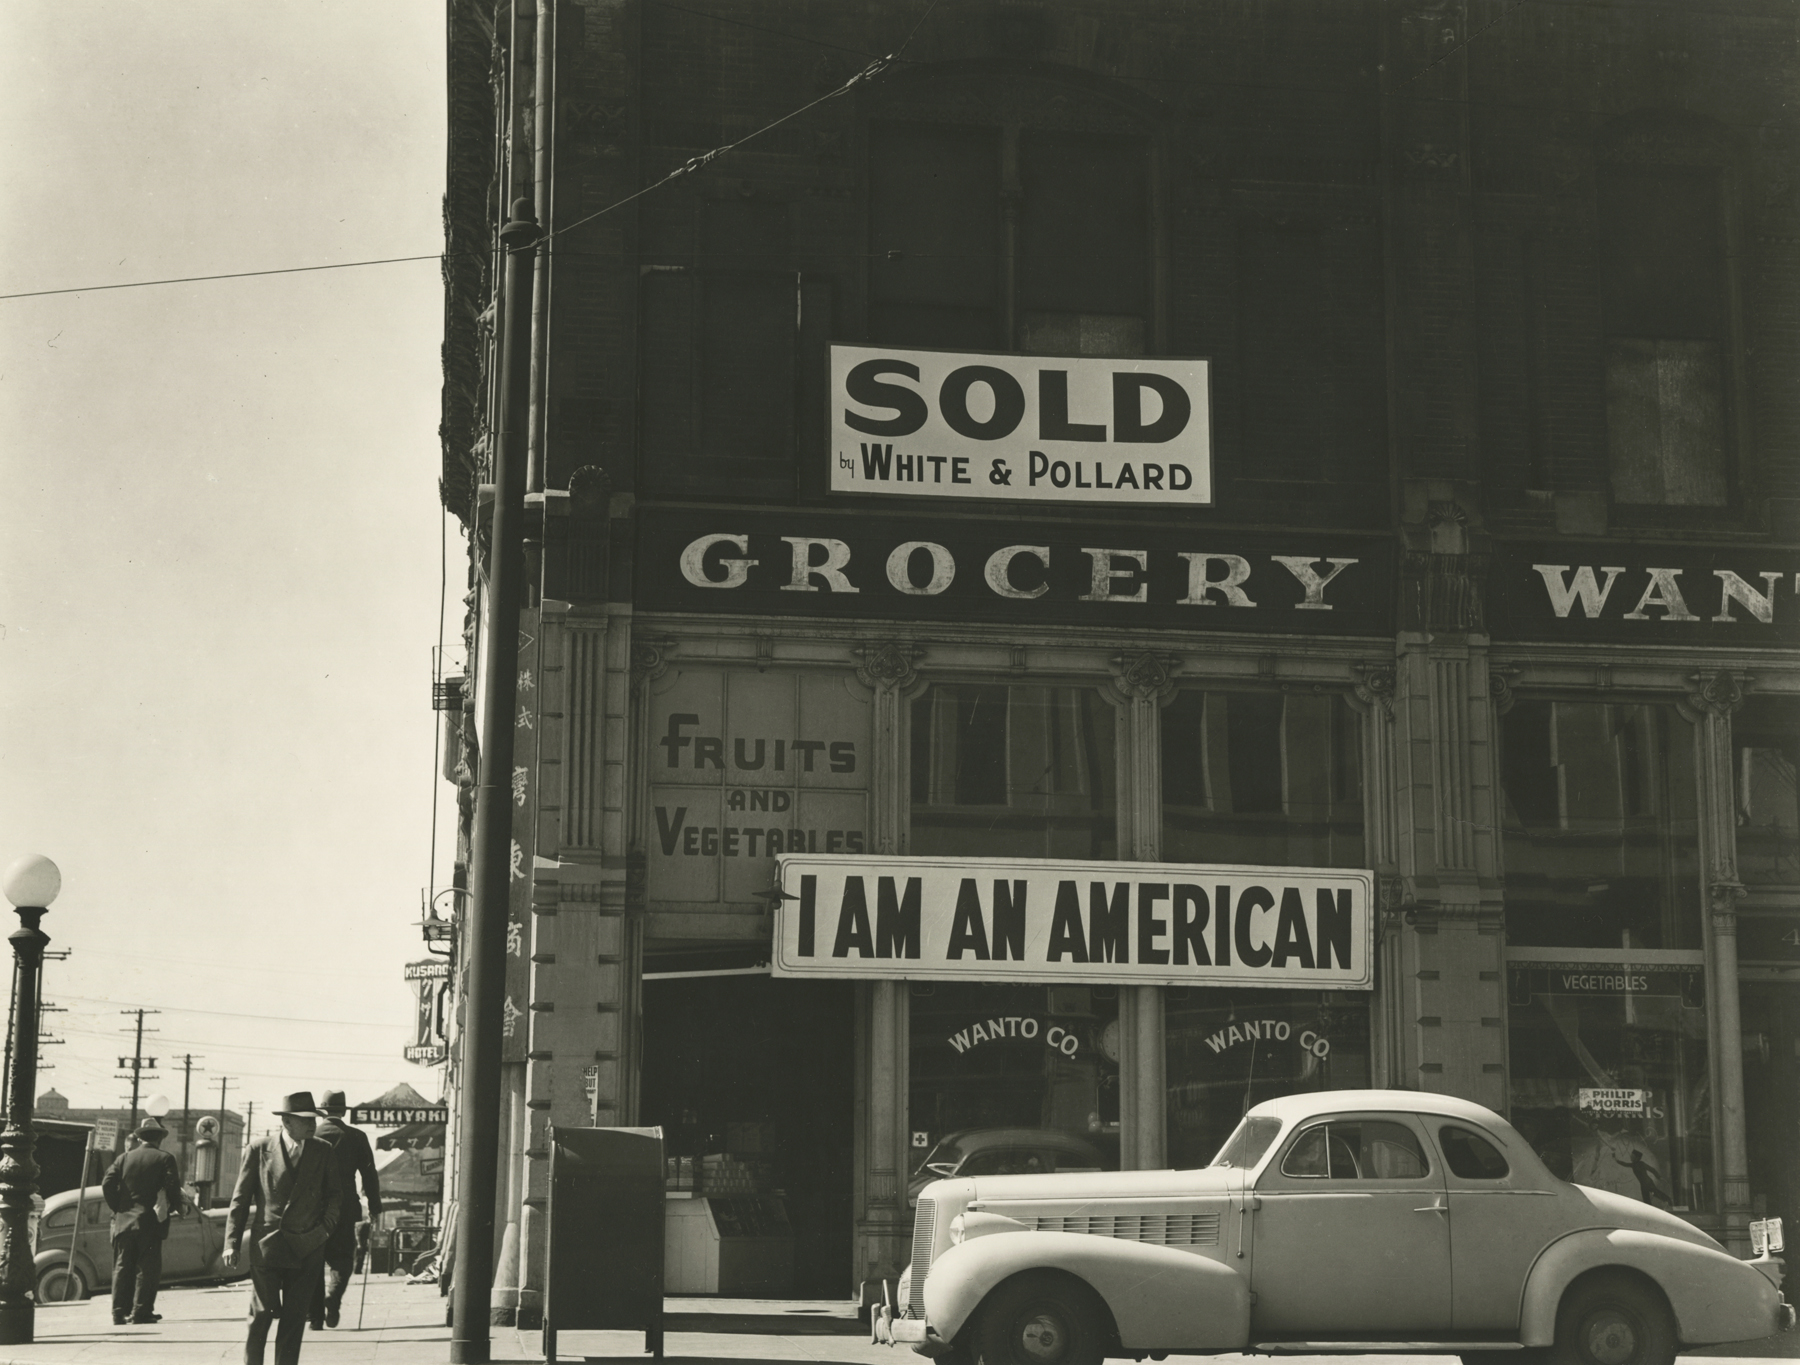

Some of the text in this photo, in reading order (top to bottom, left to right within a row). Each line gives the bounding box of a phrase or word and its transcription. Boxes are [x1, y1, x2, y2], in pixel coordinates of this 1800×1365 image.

[845, 359, 1191, 443] SOLD
[840, 443, 1193, 490] by WHITE & POLLARD
[679, 533, 1359, 610] GROCERY
[1532, 564, 1800, 623] WAN
[659, 713, 856, 773] FRUITS
[727, 789, 791, 812] AND
[655, 806, 864, 858] VEGETABLES
[798, 874, 1353, 970] I AM AN AMERICAN
[405, 964, 449, 978] KUSANO
[1562, 974, 1648, 991] VEGETABLES
[407, 1047, 440, 1059] HOTEL
[948, 1017, 1038, 1054] WANTO
[1204, 1019, 1290, 1054] WANTO
[1592, 1090, 1636, 1099] PHILIP
[1592, 1099, 1642, 1108] MORRIS
[356, 1109, 446, 1122] SUKIYAKI
